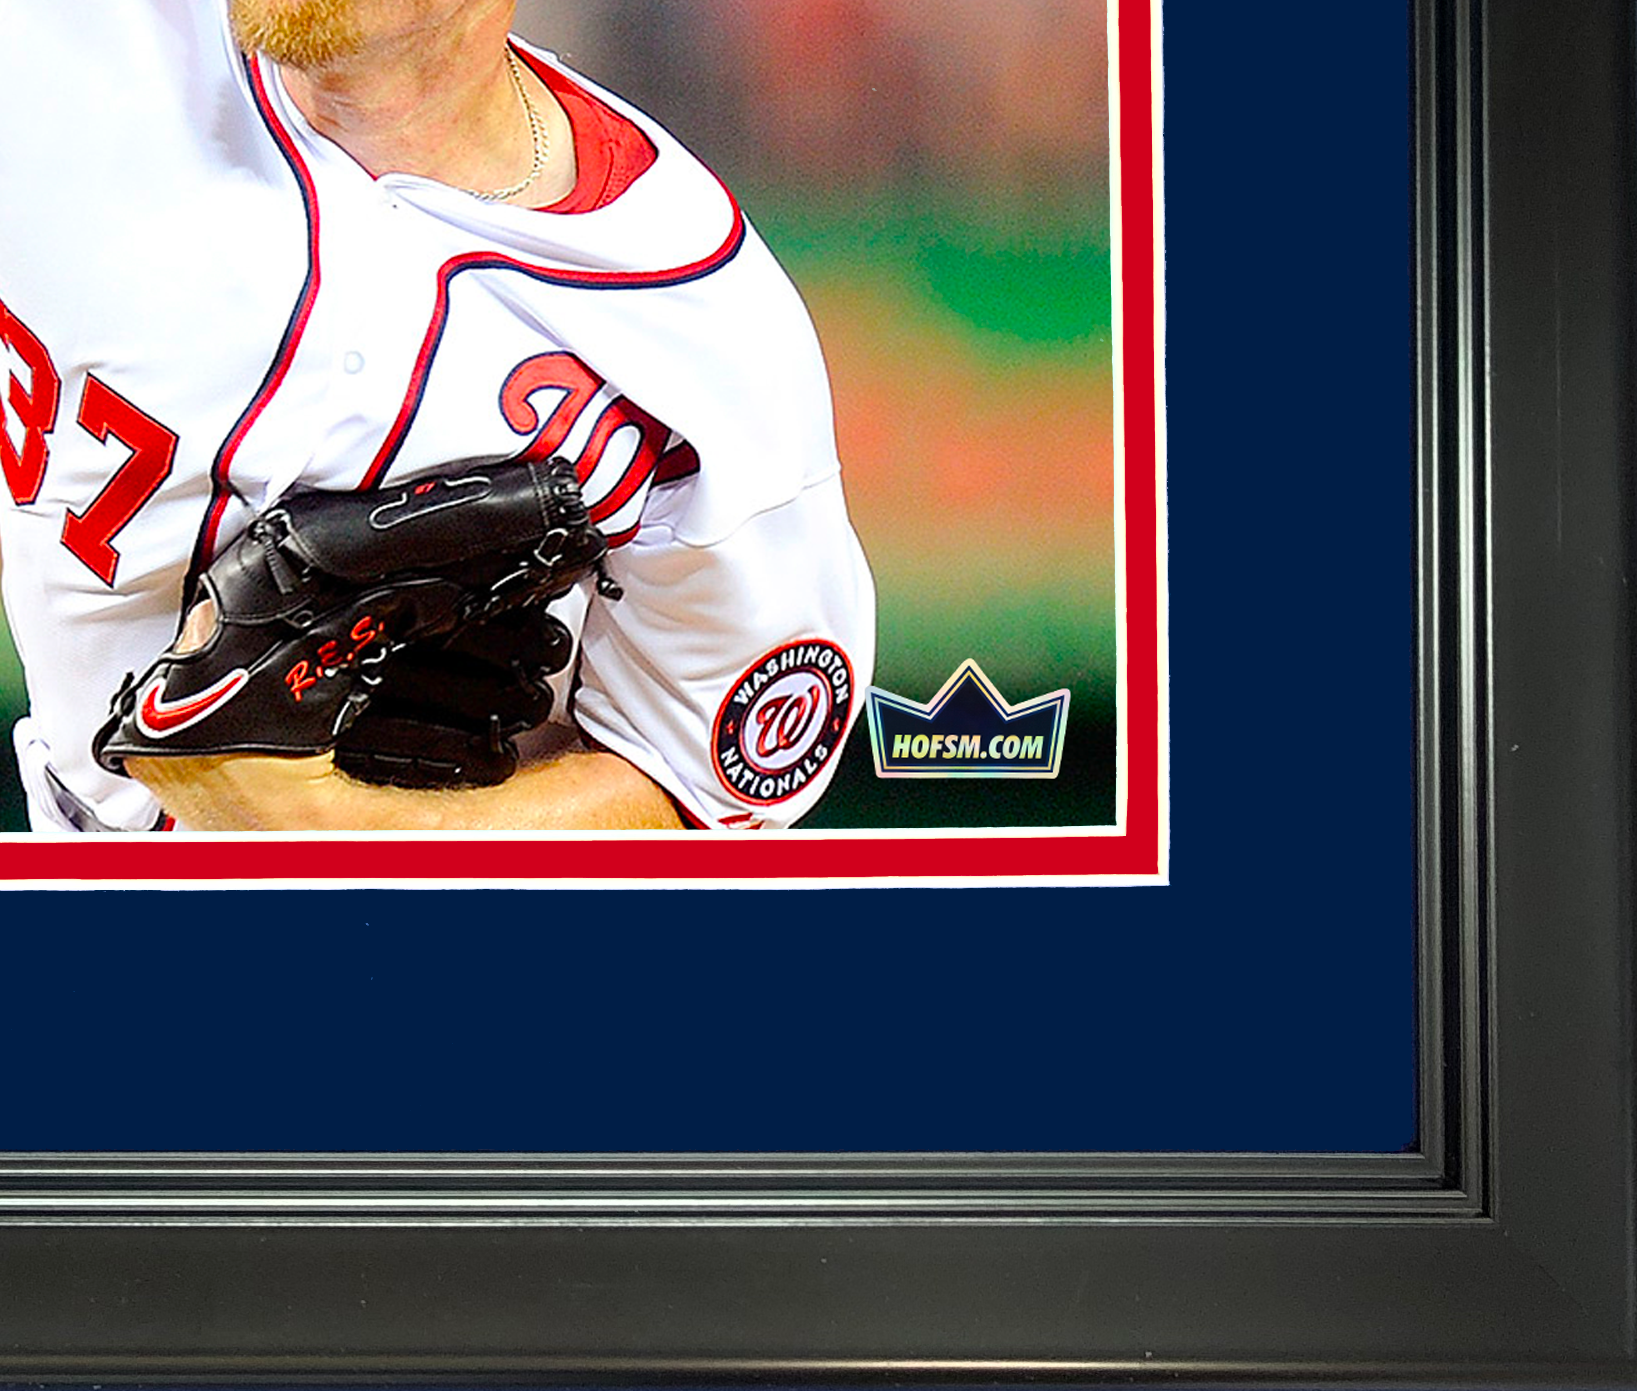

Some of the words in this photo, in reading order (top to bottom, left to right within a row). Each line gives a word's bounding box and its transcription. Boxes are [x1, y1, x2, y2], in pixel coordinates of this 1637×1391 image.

[734, 645, 849, 705] WASHINGTON
[756, 685, 821, 758] W
[720, 743, 828, 798] NATIONALS
